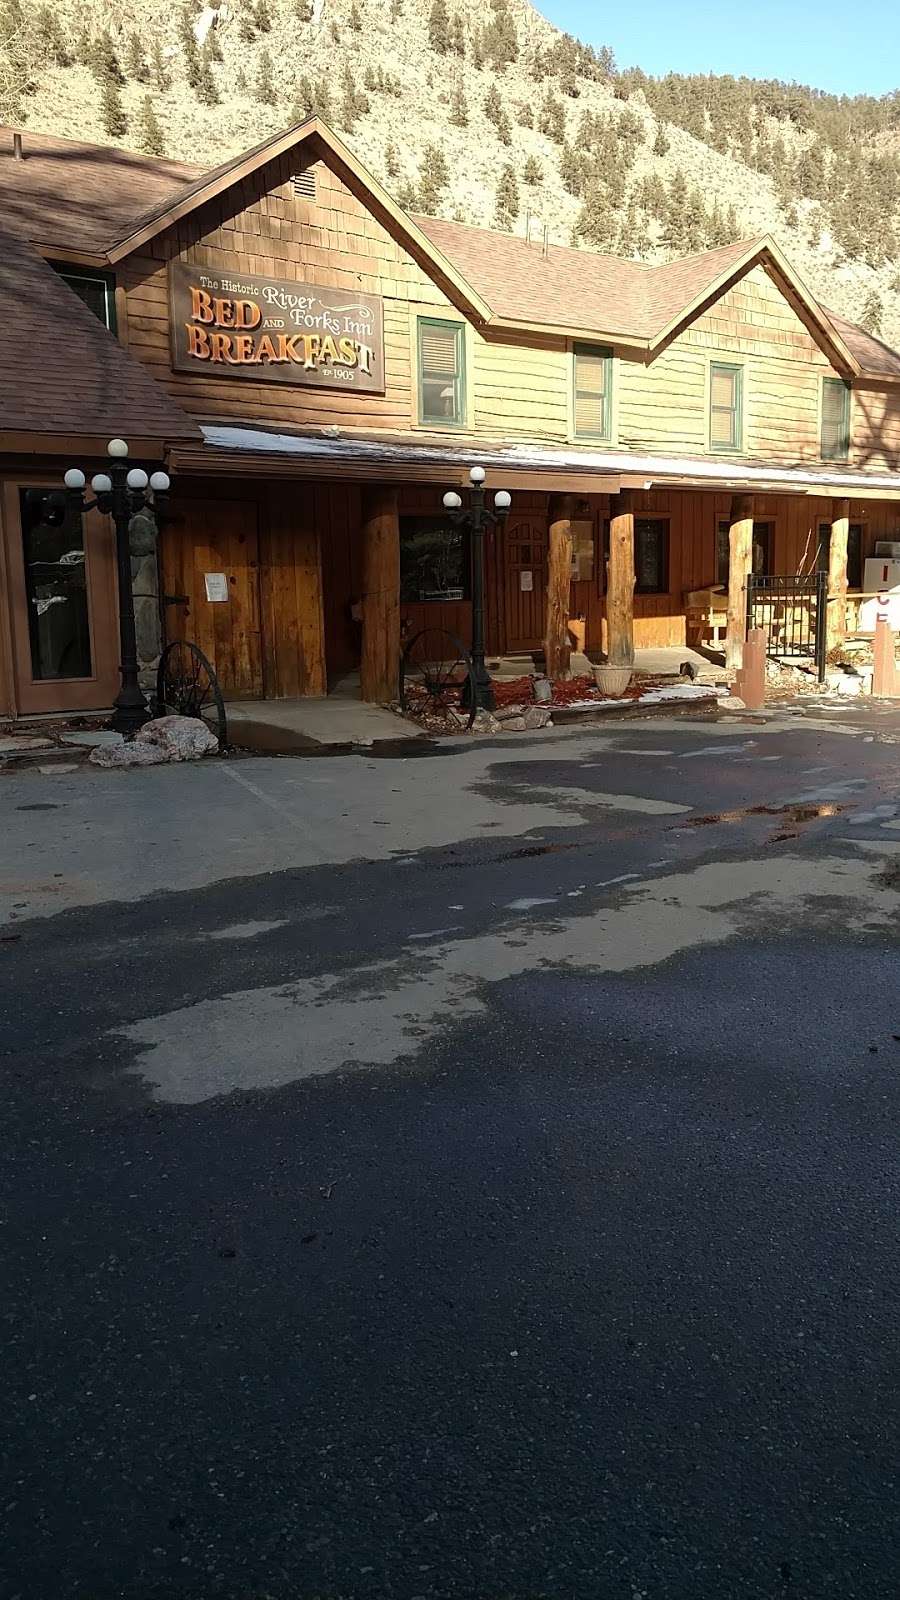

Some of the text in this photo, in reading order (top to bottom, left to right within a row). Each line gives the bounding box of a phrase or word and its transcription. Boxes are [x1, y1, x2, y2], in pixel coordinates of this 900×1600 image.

[190, 286, 285, 329] BED AND
[200, 276, 316, 310] The Historic River
[290, 309, 373, 336] Forks Inn
[185, 323, 373, 374] BREAKFAST
[333, 369, 355, 381] 1905
